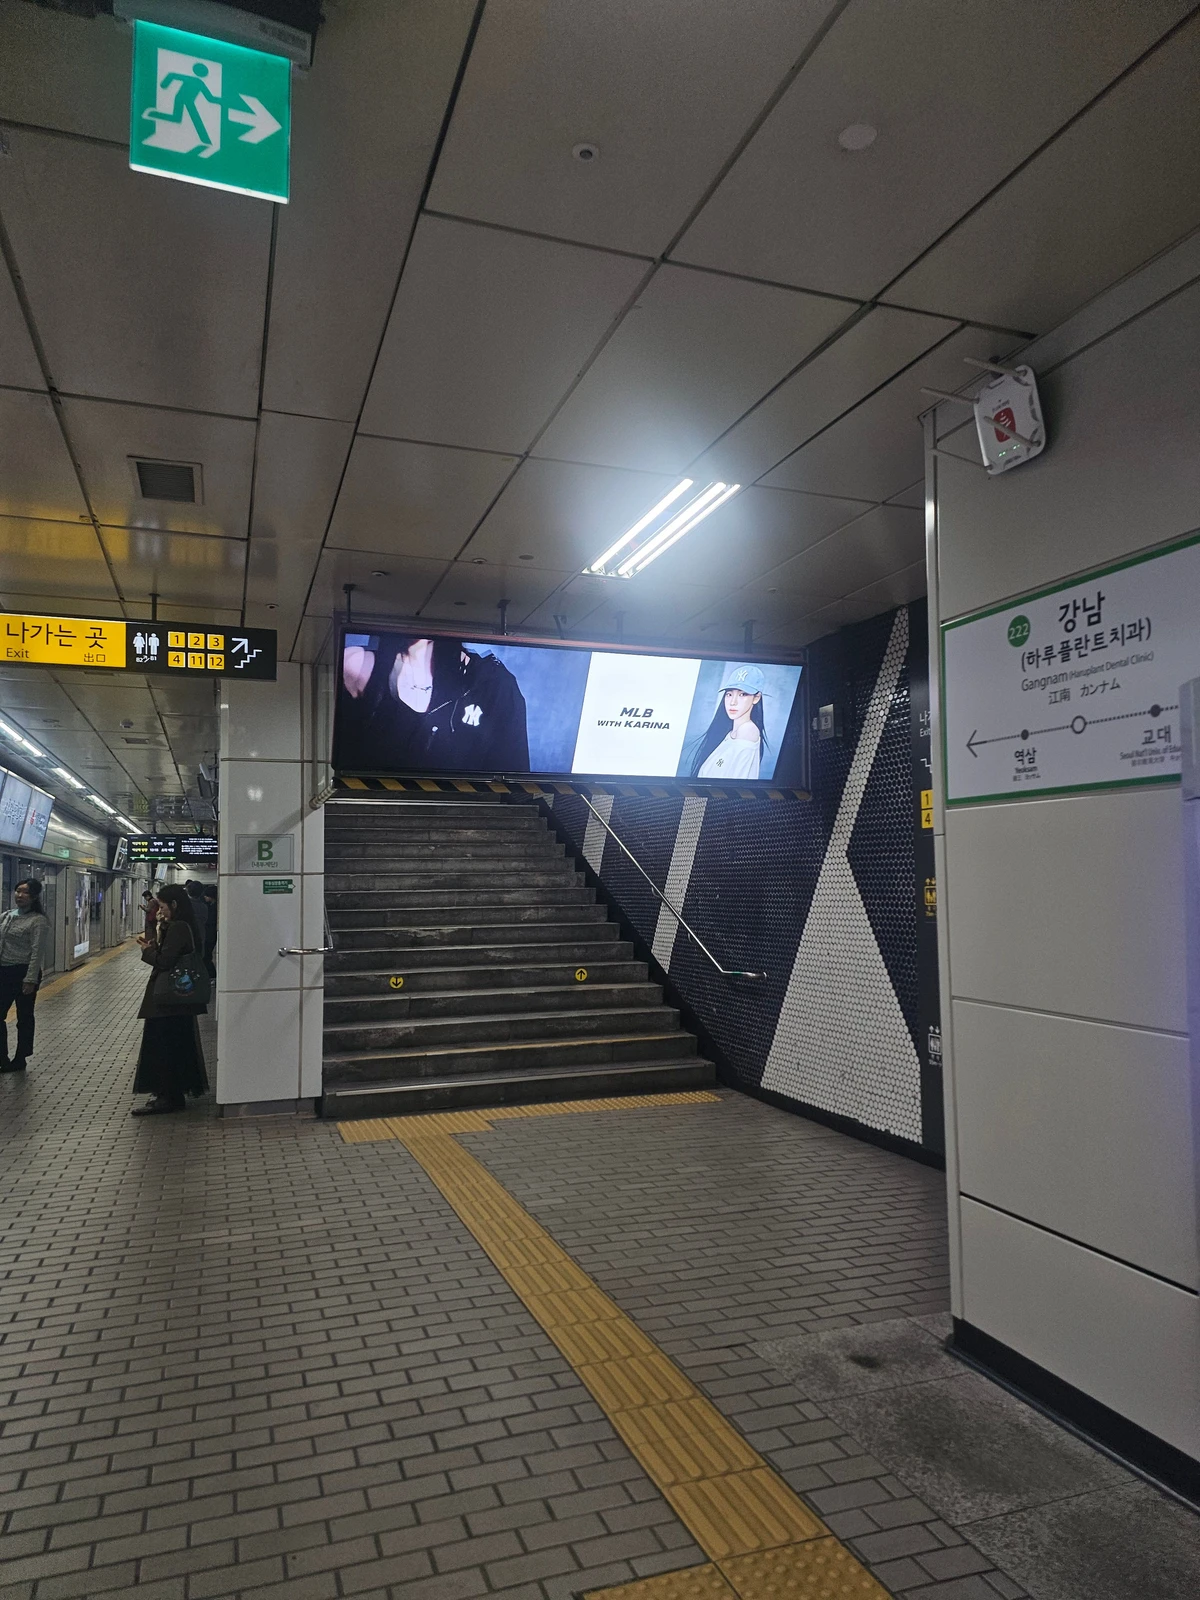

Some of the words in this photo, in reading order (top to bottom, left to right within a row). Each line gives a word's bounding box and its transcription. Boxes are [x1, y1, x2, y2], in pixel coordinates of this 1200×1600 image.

[1058, 591, 1105, 633] 강남
[6, 621, 77, 648] 나가는
[85, 626, 107, 649] 곳
[1009, 623, 1029, 640] 222
[193, 636, 200, 645] 2
[213, 637, 220, 646] 3
[1021, 617, 1152, 672] (하루플란트치과)
[6, 648, 30, 659] Exit
[83, 652, 106, 663] 出口
[173, 655, 181, 664] 4
[191, 656, 202, 665] 11
[210, 656, 222, 666] 12
[1021, 672, 1068, 691] Gangnam
[1106, 657, 1129, 671] Dental
[1048, 688, 1071, 705] 江南
[1080, 678, 1121, 698] カンナム
[620, 707, 653, 718] MLB
[597, 720, 621, 728] WITH
[624, 720, 670, 730] KARINA
[1141, 725, 1171, 745] 교대
[1014, 747, 1037, 765] 역삼
[925, 794, 930, 805] 1
[925, 813, 931, 824] 4
[257, 840, 273, 860] B
